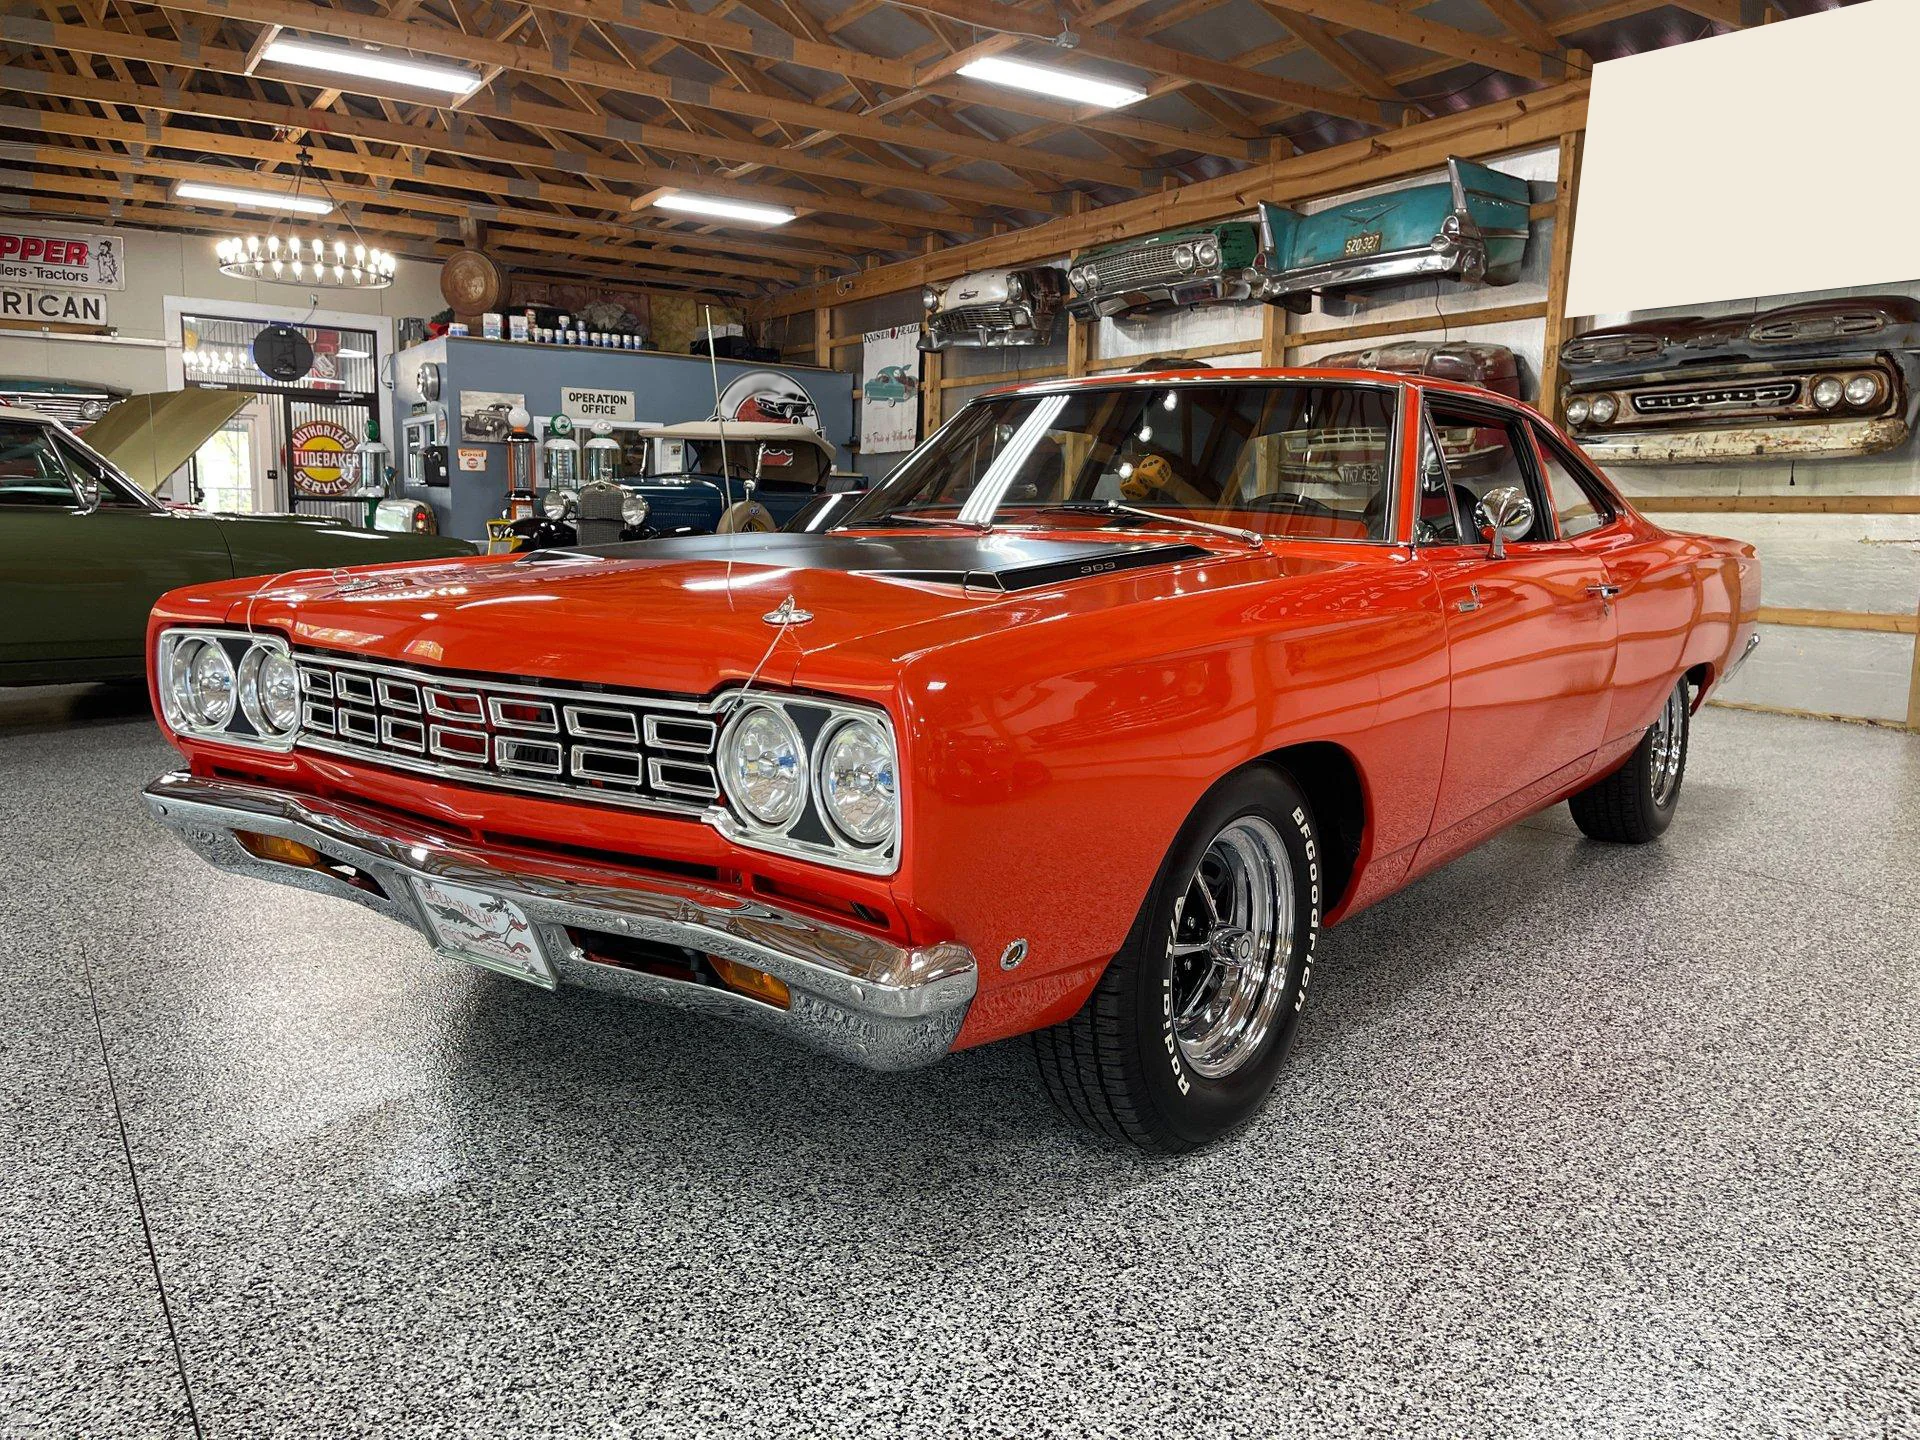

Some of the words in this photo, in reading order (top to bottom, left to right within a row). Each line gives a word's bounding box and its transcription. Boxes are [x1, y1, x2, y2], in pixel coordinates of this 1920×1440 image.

[34, 266, 89, 282] Tractors
[3, 291, 100, 320] RICAN
[568, 392, 627, 405] OPERATION
[581, 404, 616, 414] OFFICE
[292, 424, 354, 450] AUTHORIZED
[293, 451, 359, 467] TUDEBAKER
[294, 469, 355, 493] SERVICE
[1080, 561, 1116, 574] 383
[1291, 806, 1319, 1013] BFGoodrich
[1163, 978, 1191, 1096] Radial
